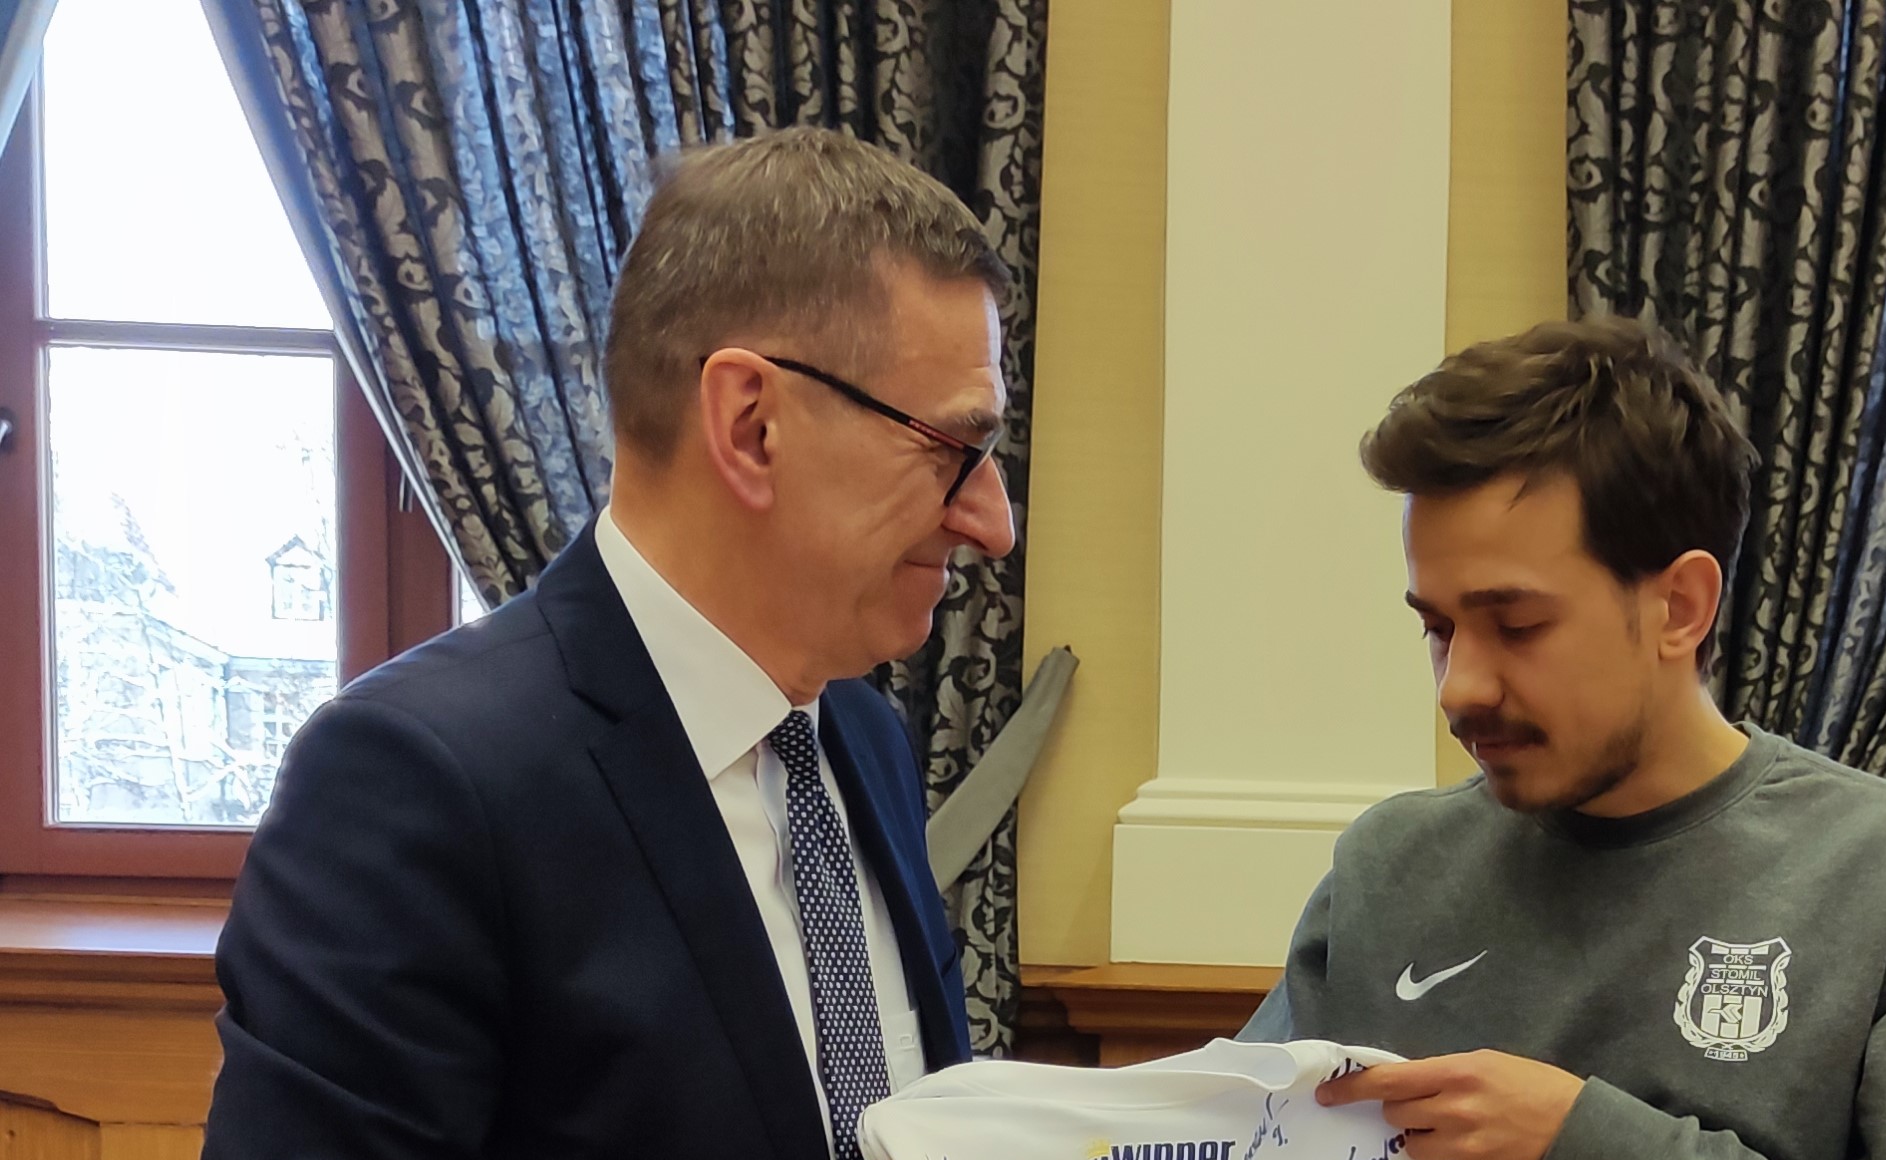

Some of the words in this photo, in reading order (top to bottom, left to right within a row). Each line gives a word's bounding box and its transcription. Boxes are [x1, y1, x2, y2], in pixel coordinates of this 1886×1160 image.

[1722, 954, 1754, 965] OKS
[1710, 968, 1762, 981] STOMIL
[1700, 983, 1769, 998] OLSZTYN
